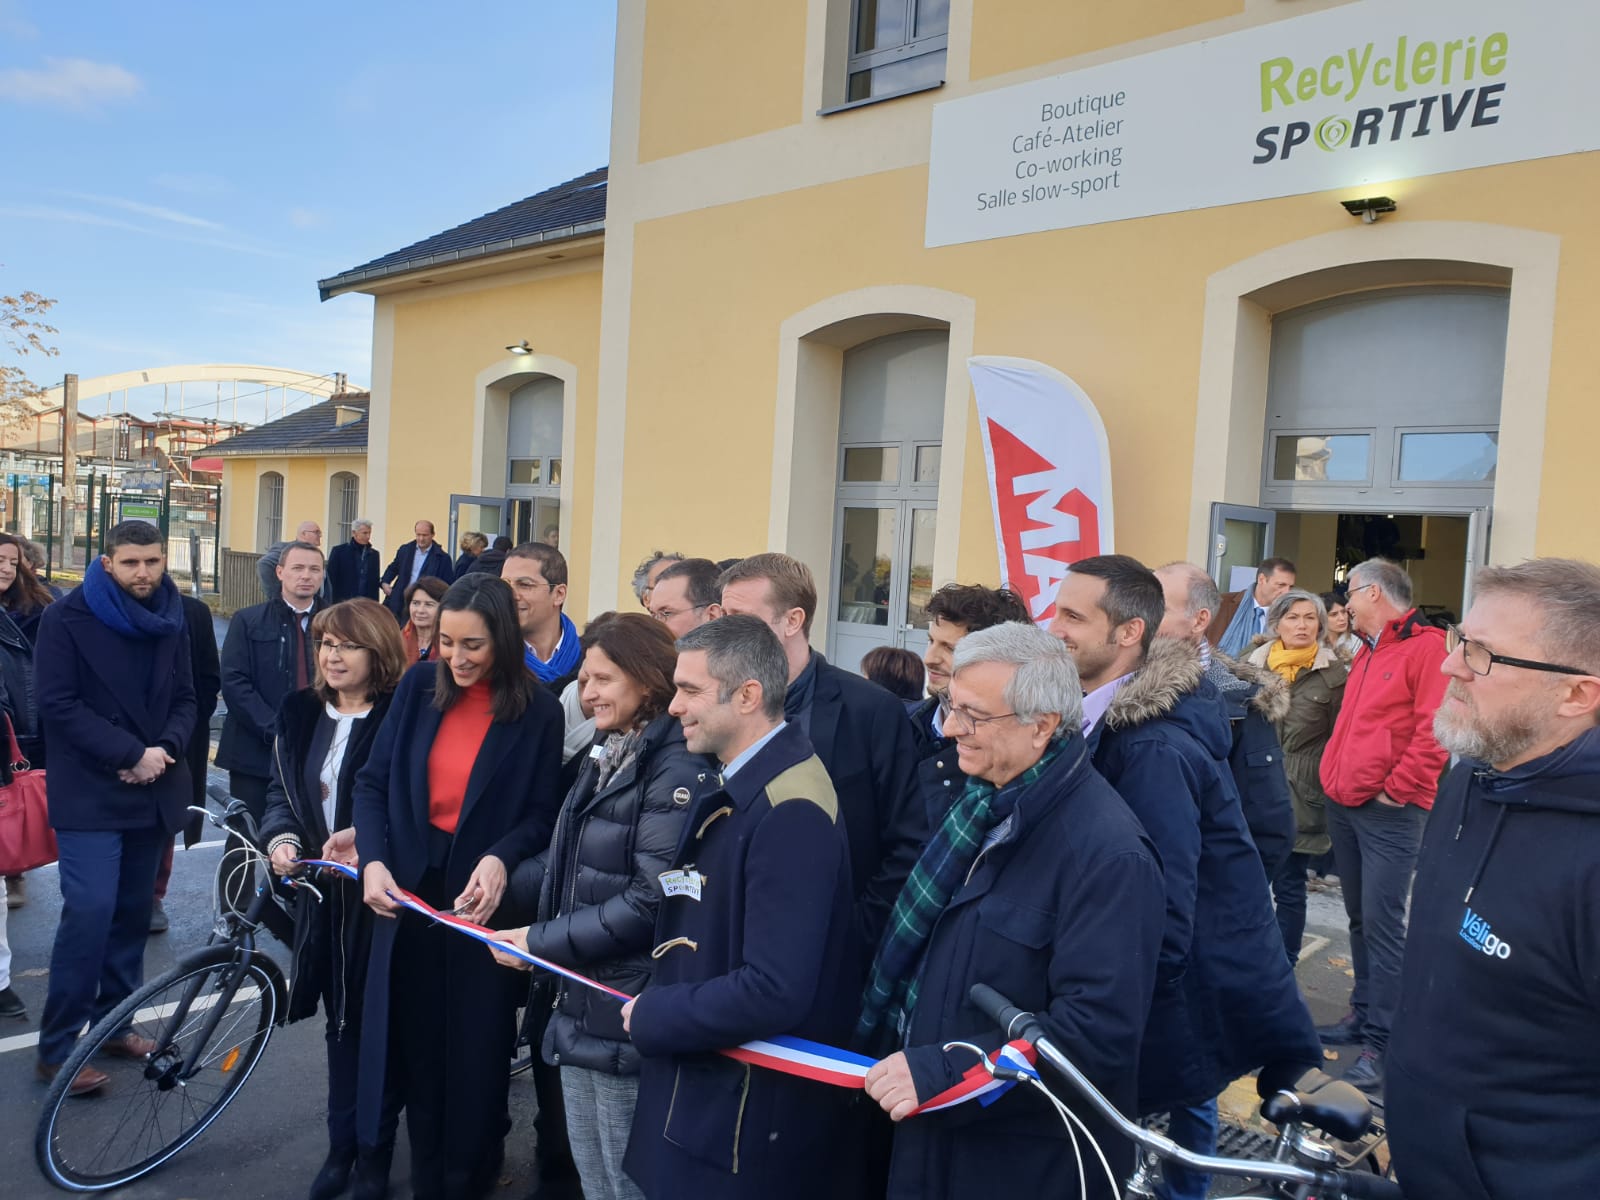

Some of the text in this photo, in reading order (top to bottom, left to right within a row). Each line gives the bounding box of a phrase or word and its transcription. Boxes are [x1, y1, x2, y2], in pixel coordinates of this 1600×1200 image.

[1041, 90, 1126, 122] Boutique
[1252, 82, 1506, 165] SPORTIVE
[1012, 119, 1125, 154] Café-Atelier
[1015, 147, 1123, 179] Co-working
[976, 170, 1120, 211] Salle slow-sport
[1462, 908, 1511, 959] Véligo
